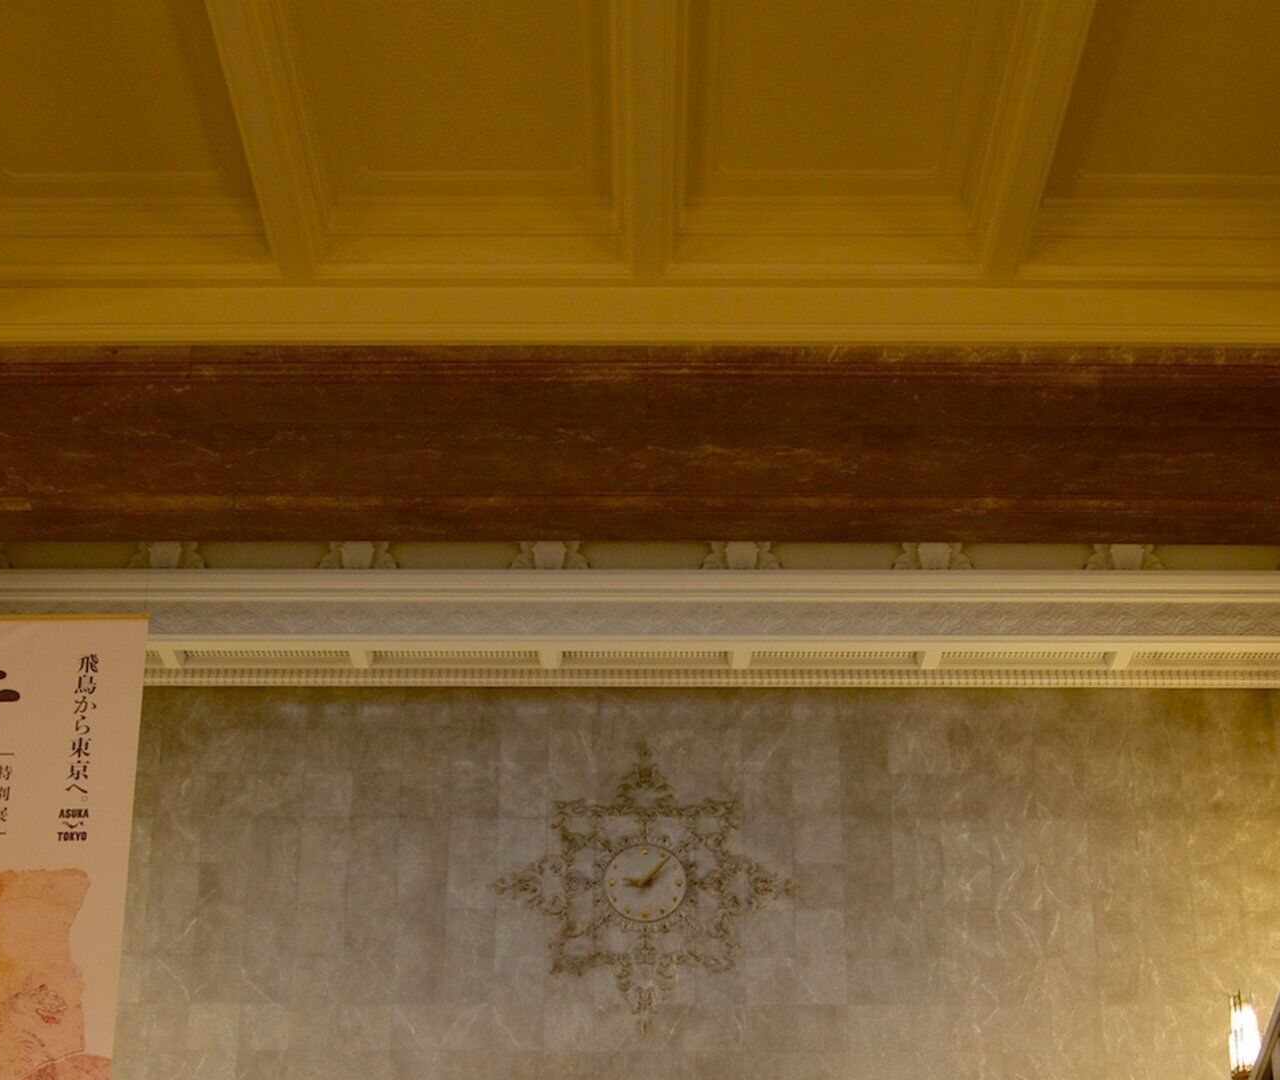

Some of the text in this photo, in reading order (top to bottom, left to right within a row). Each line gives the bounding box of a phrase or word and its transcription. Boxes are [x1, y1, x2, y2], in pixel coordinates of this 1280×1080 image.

[65, 653, 99, 802] 飛鳥から東京へ。
[58, 808, 90, 819] ASUKA
[57, 831, 88, 842] TOKYO
